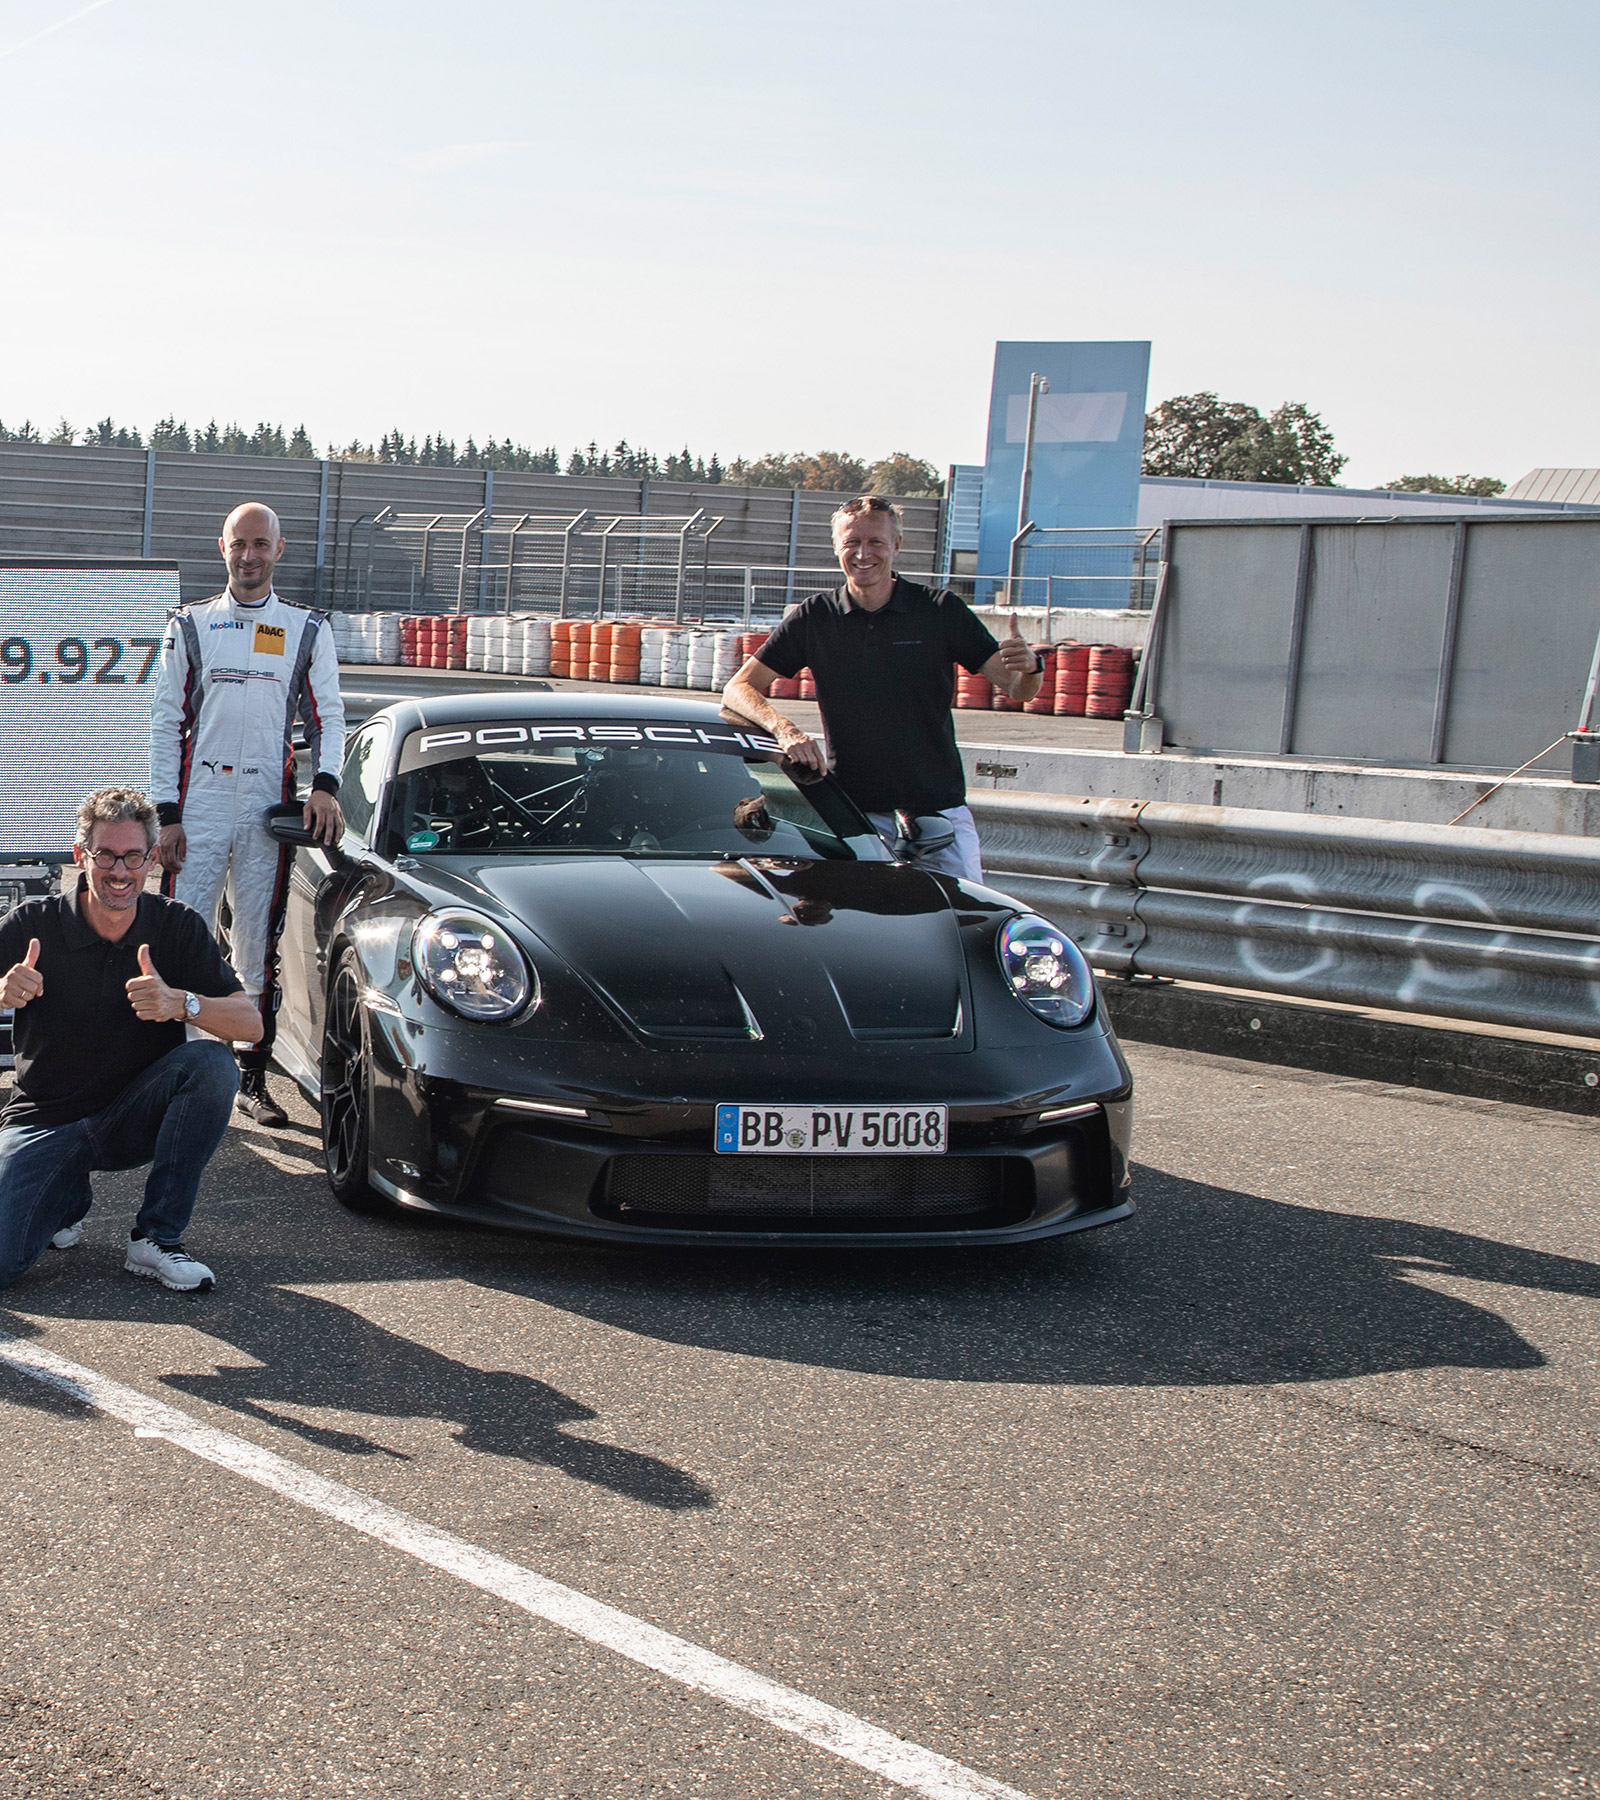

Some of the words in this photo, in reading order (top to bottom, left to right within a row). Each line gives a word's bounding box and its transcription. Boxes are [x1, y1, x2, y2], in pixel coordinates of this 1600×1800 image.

[210, 621, 234, 631] Mobil
[257, 624, 284, 638] ADAC
[211, 668, 275, 677] PORSCHE
[419, 725, 787, 754] PORSCHE
[742, 1111, 784, 1147] BB
[812, 1112, 853, 1147] PV
[862, 1111, 941, 1147] 5008
